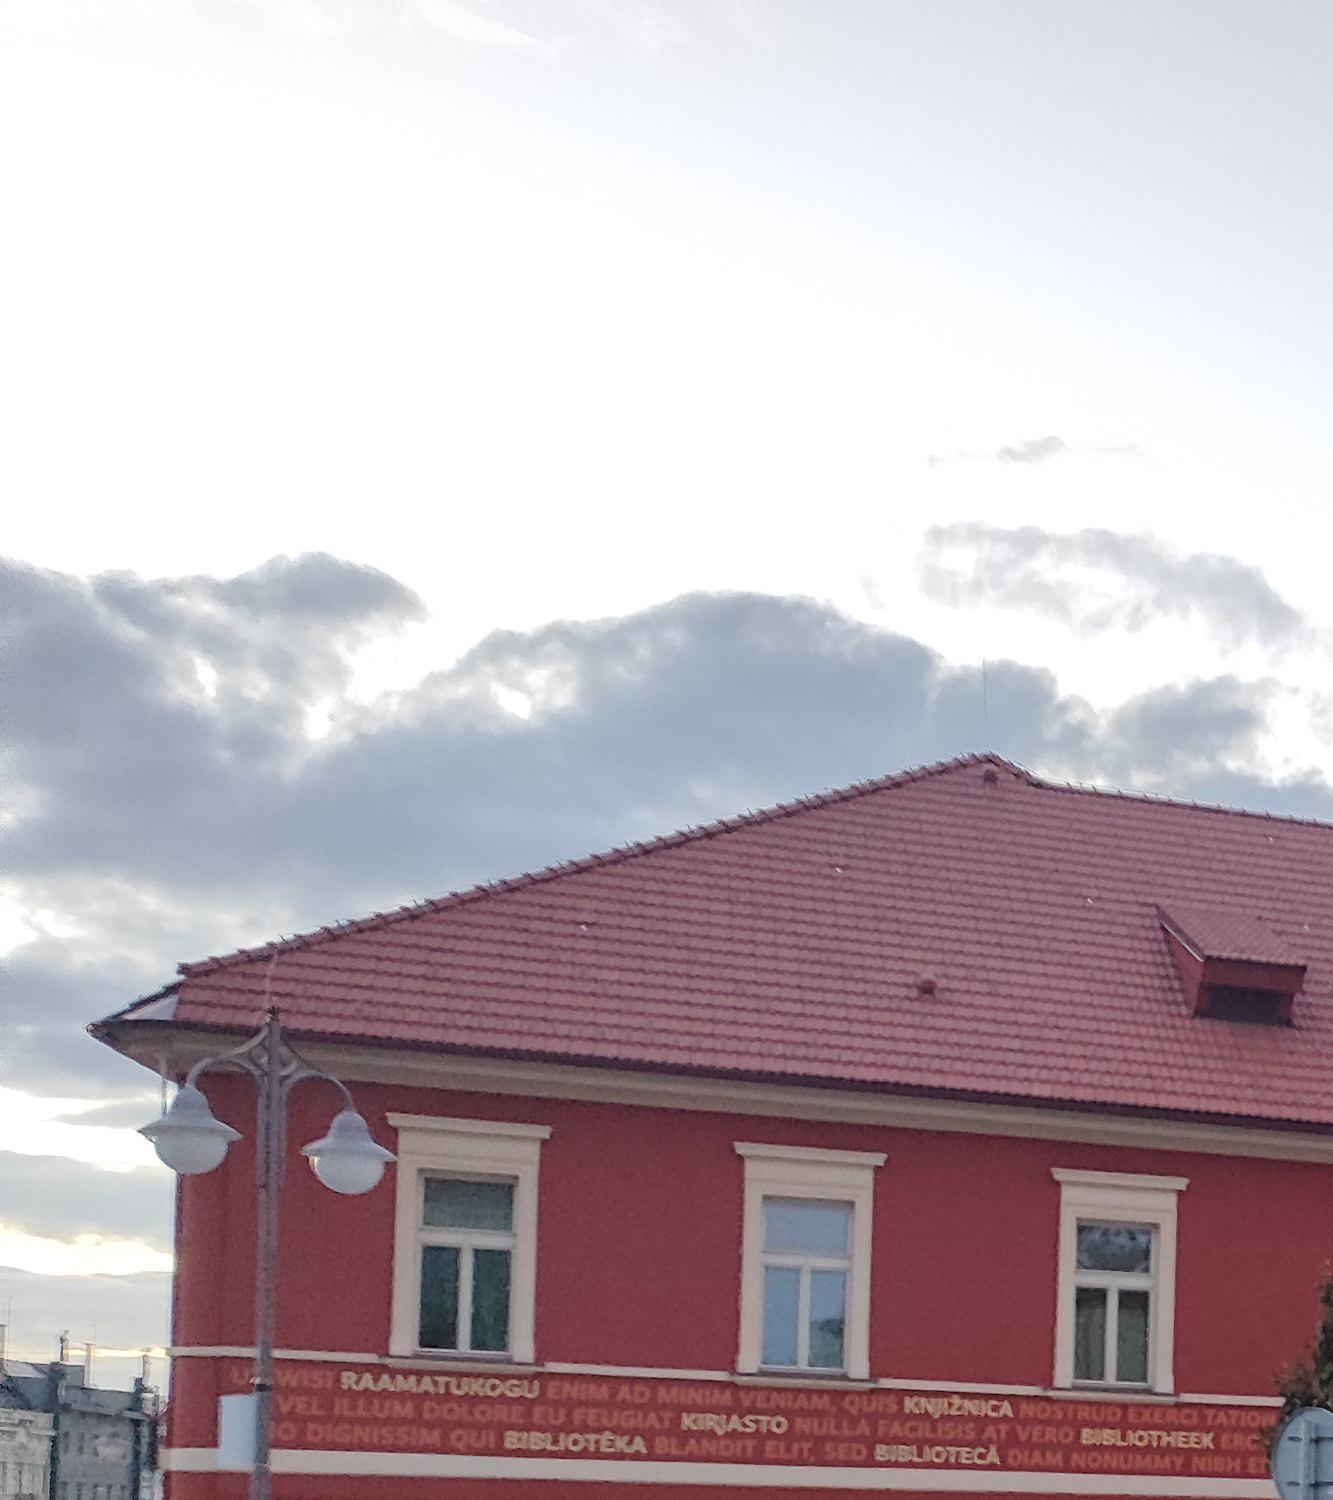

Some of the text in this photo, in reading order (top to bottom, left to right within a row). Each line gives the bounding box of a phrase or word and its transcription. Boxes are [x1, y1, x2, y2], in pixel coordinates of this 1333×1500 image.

[334, 1397, 418, 1420] ILLUM
[422, 1401, 528, 1423] DOLORE
[573, 1408, 676, 1430] FEUGIAT
[681, 1412, 790, 1437] KIRJASTO
[794, 1416, 870, 1437] NULLA
[877, 1420, 977, 1441] FACILISIS
[1015, 1425, 1076, 1444] VERO
[1080, 1427, 1216, 1450] BIBLIOTHEEK
[340, 1370, 541, 1399] RAAMATUKOGU
[547, 1380, 610, 1402] ENIM
[615, 1384, 651, 1404] AD
[656, 1386, 733, 1408] MINIM
[904, 1395, 1015, 1419] KNJIŽNICA
[1020, 1401, 1123, 1423] NOSTRUD
[1127, 1406, 1199, 1425] EXERCI
[307, 1422, 444, 1448] DIGNISSIM
[449, 1428, 497, 1451] QUI
[655, 1435, 757, 1459] BLANDIT
[824, 1443, 867, 1461] SED
[1007, 1446, 1064, 1468] DIAM
[1071, 1449, 1185, 1472] NONUMMY
[1191, 1455, 1241, 1473] NIBH
